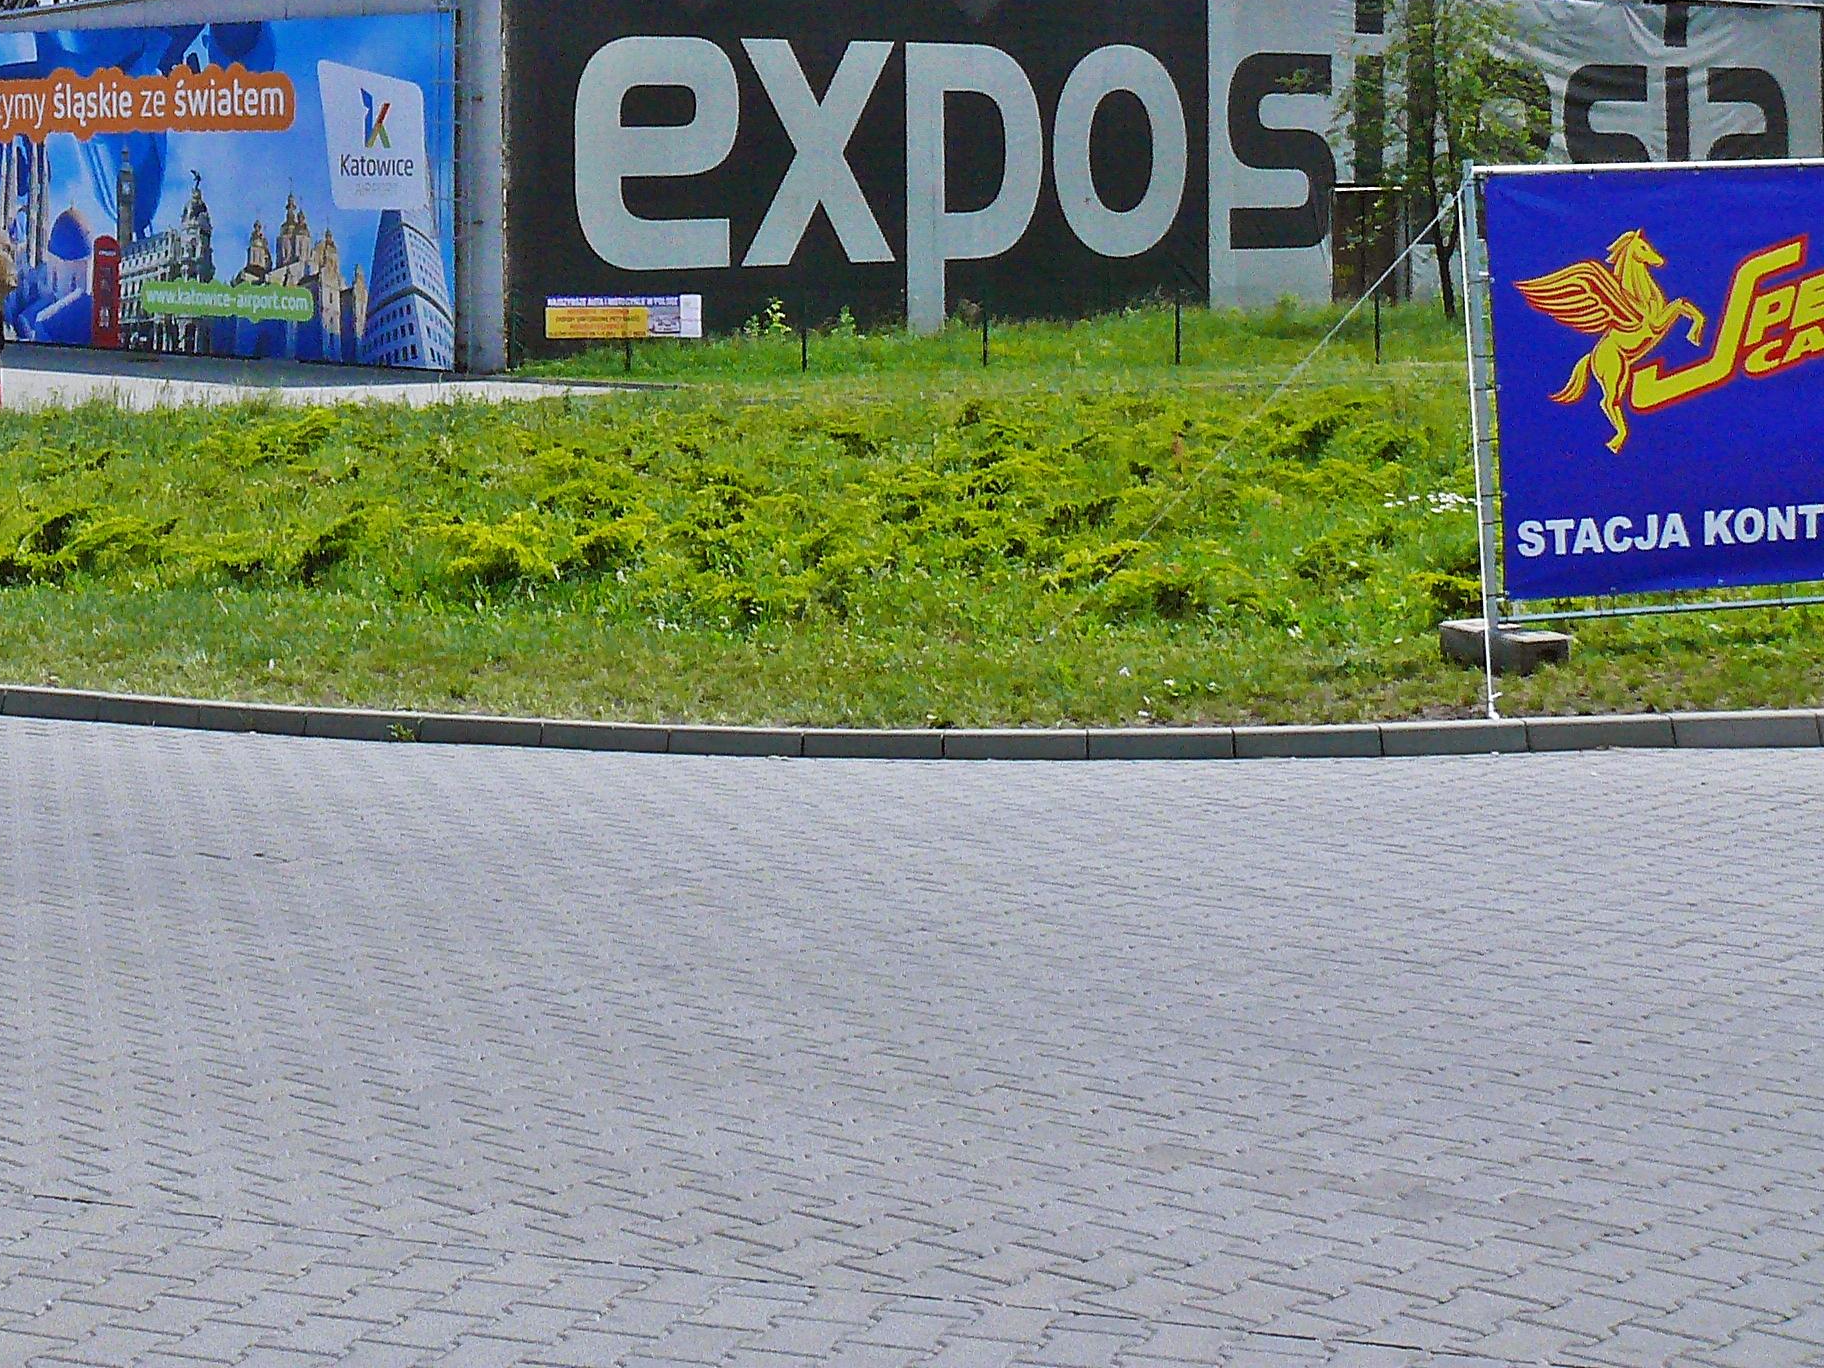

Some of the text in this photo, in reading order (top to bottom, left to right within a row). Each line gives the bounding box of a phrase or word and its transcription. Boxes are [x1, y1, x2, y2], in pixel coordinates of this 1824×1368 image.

[53, 80, 133, 127] śląskie
[140, 87, 166, 118] ze
[174, 78, 286, 118] światem
[340, 154, 414, 177] Katowice
[145, 286, 309, 314] www.katowice-airport.com
[1518, 504, 1824, 558] STACJA KONT
